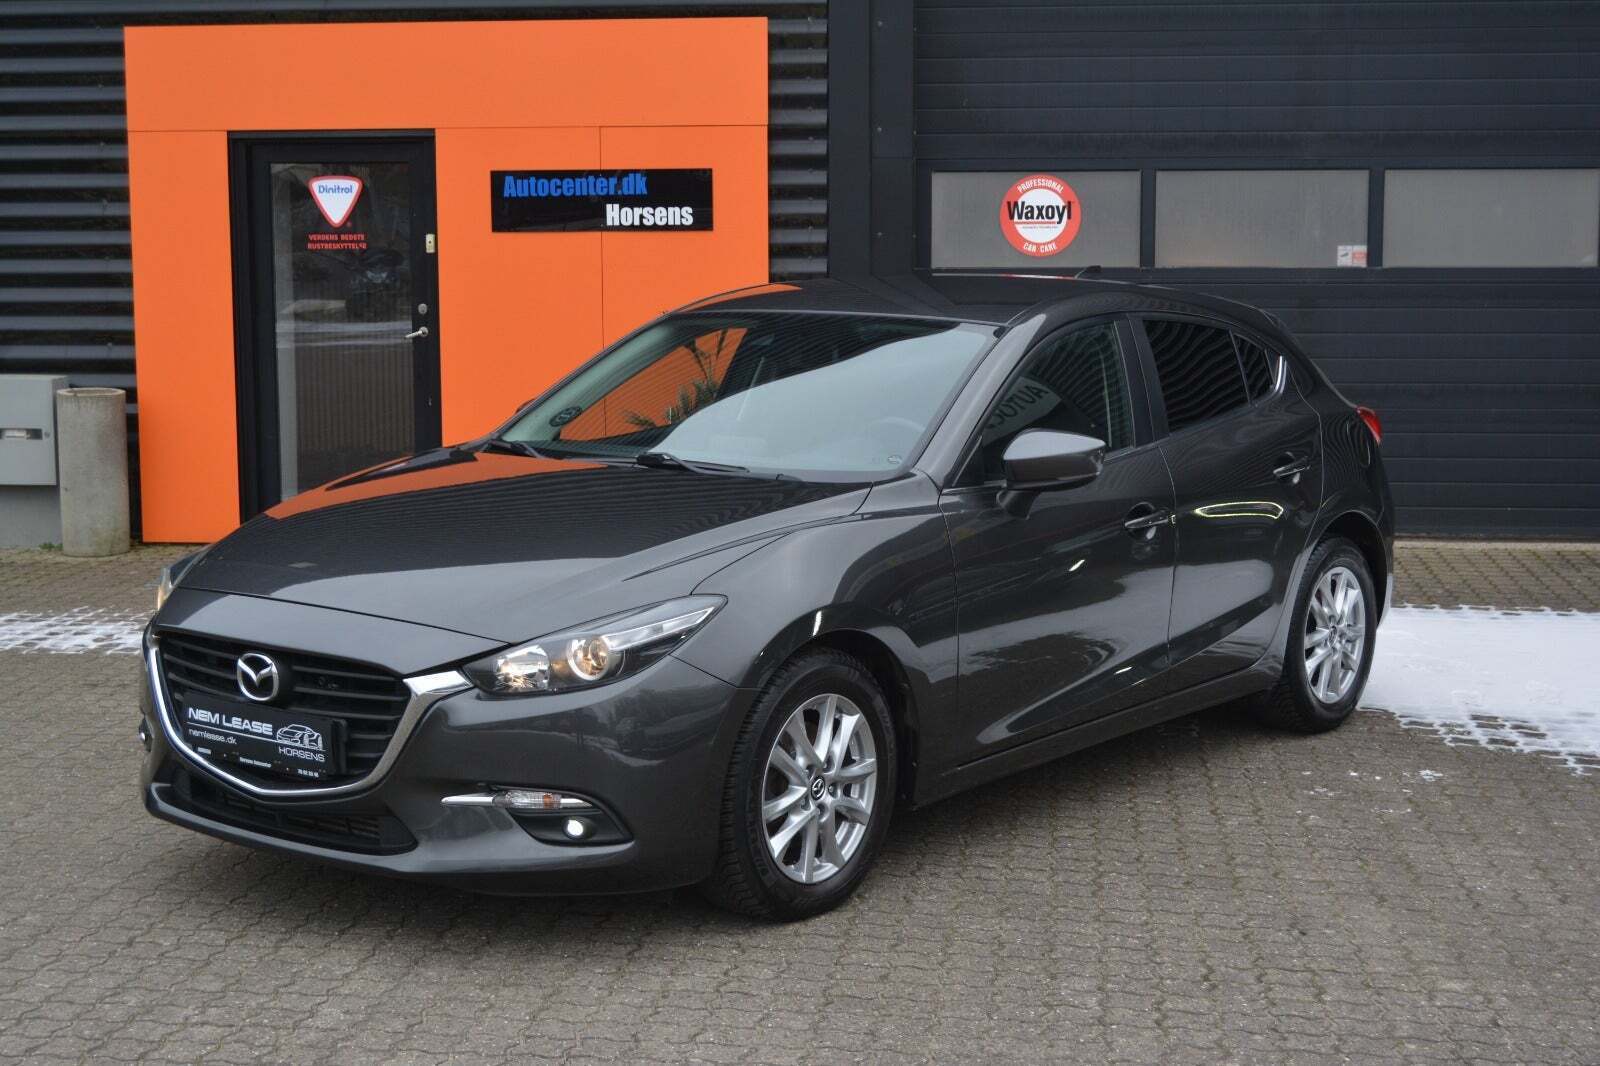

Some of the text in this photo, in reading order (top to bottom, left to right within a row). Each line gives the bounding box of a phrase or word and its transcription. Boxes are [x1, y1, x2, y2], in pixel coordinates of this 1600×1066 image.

[318, 184, 353, 194] Dinitrol
[503, 173, 648, 198] Autocenter.dk
[1016, 178, 1064, 193] PROFESSIONAL
[605, 203, 694, 227] Horsens
[1006, 200, 1072, 225] Waxoyl
[1023, 242, 1057, 253] CAR CARE
[187, 707, 273, 736] NEM LEASE
[278, 746, 326, 763] HORSENS
